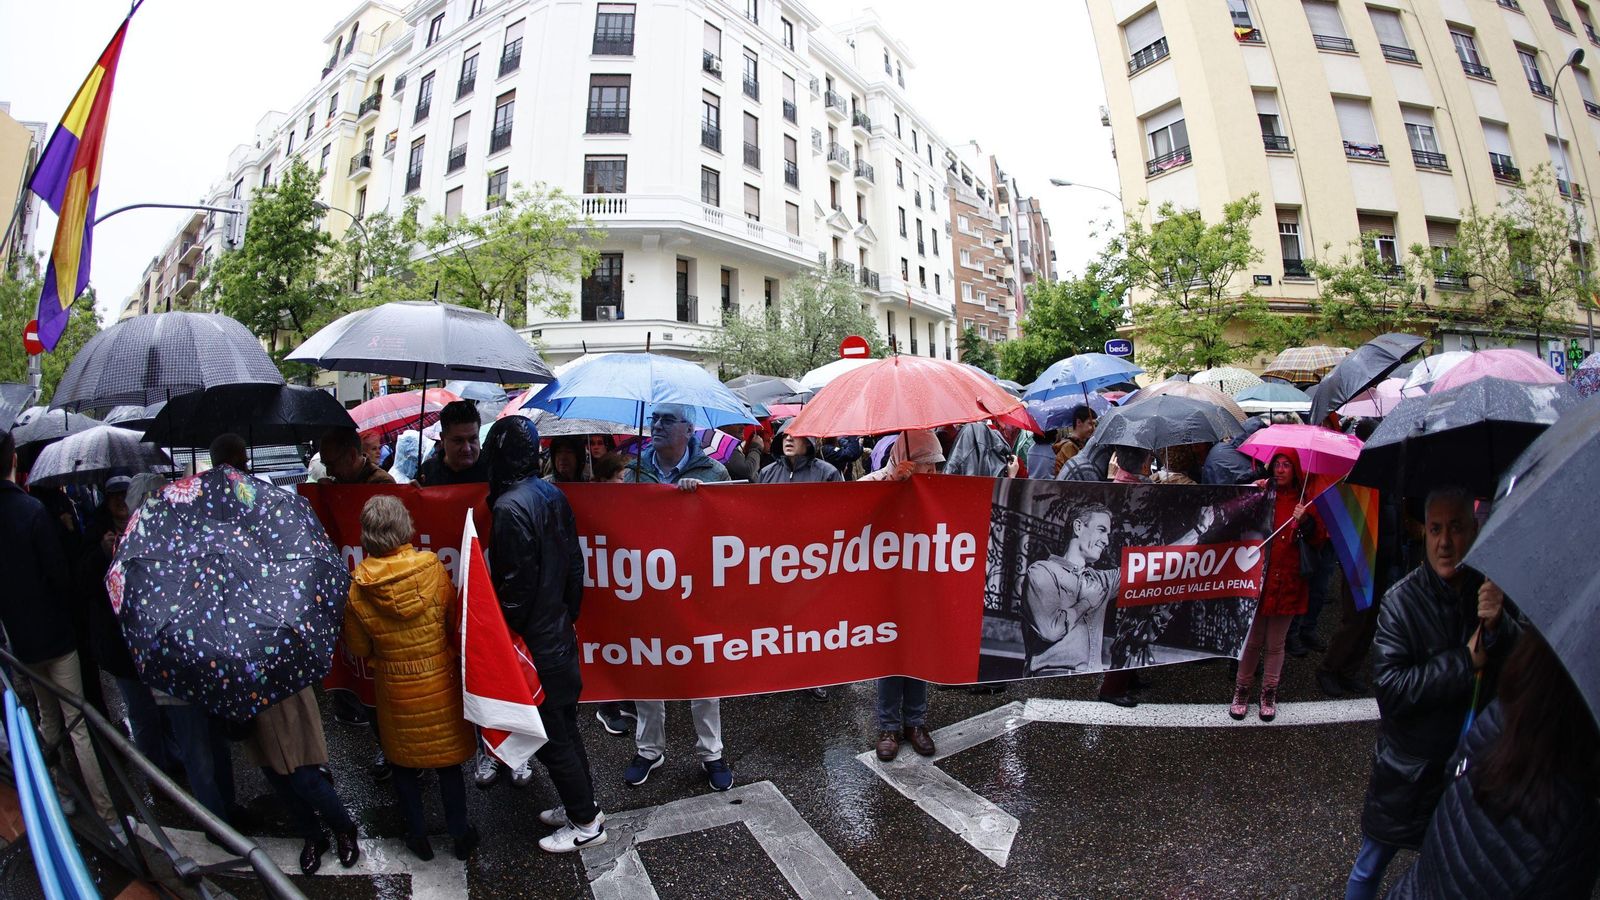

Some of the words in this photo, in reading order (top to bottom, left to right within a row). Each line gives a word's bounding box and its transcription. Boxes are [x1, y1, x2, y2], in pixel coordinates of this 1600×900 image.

[1551, 352, 1561, 371] P
[578, 535, 692, 601] tigo,
[712, 523, 976, 587] Presidente
[1124, 587, 1162, 599] CLARO
[1164, 585, 1185, 596] QUE
[1188, 582, 1211, 593] VALE
[1213, 581, 1225, 590] LA
[1227, 579, 1257, 590] PENA.
[582, 621, 898, 666] roNoTeRindas
